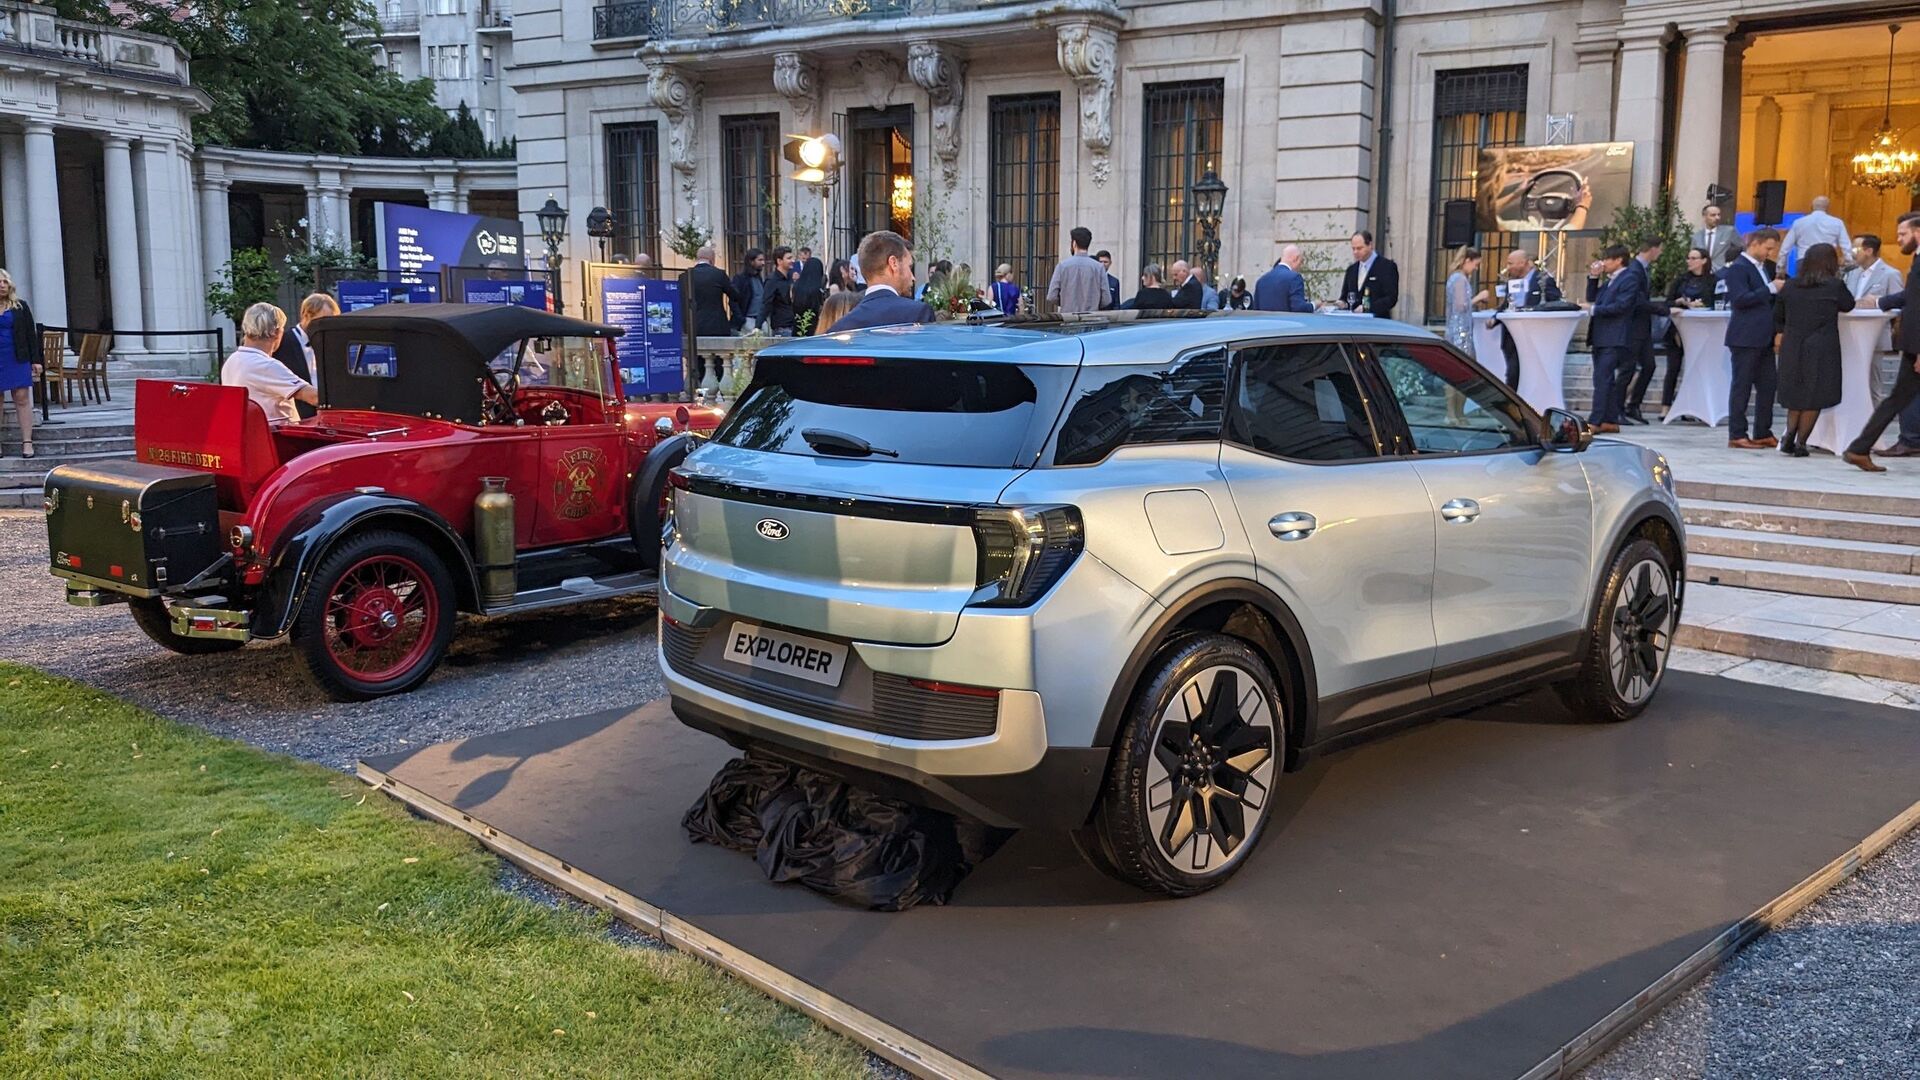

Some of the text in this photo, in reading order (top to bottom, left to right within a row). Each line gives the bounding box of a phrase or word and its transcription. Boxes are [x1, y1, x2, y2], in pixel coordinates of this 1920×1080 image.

[171, 450, 193, 465] FIRE
[195, 453, 224, 469] DEPT.
[570, 450, 597, 464] FIRE
[761, 521, 783, 537] Ford
[733, 632, 833, 674] EXPLORER
